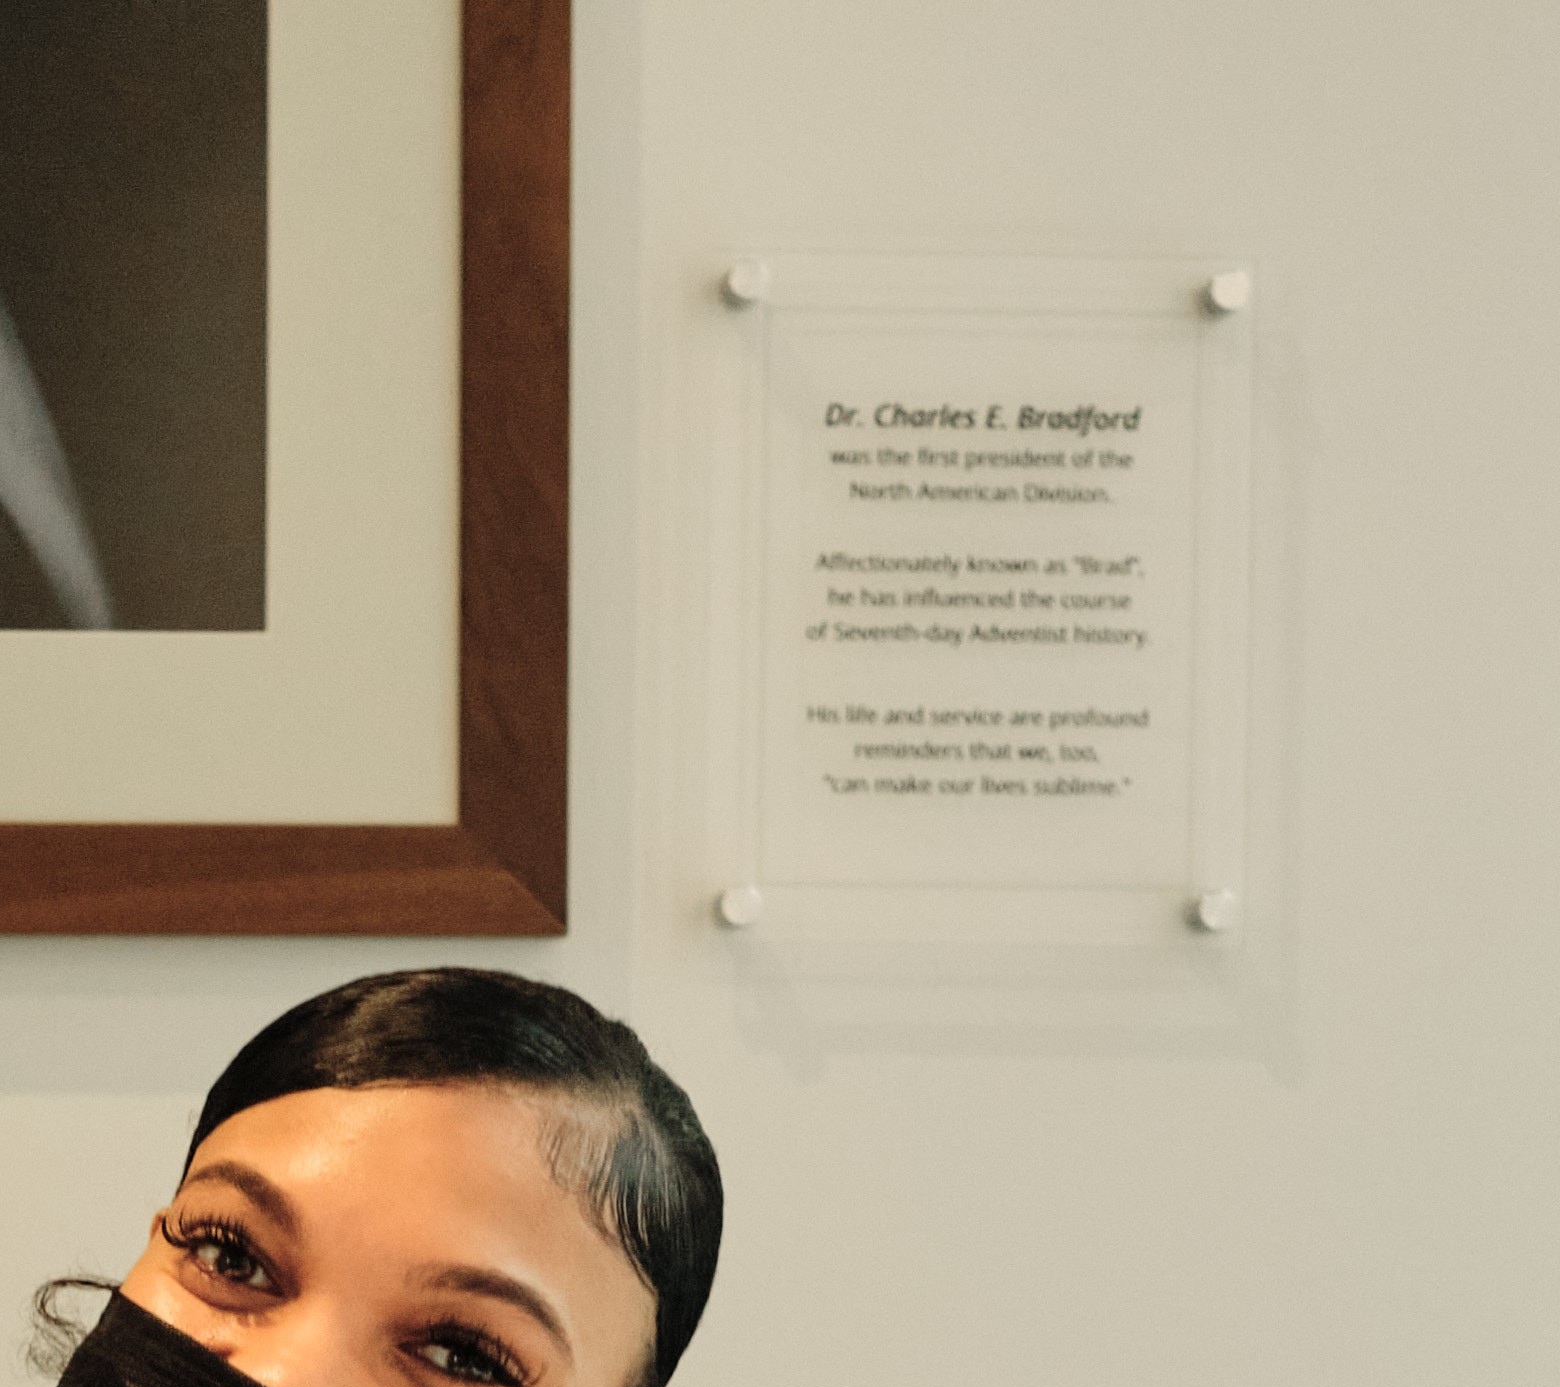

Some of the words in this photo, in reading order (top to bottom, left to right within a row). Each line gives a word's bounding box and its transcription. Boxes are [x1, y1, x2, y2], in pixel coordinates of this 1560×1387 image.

[825, 403, 864, 428] Dr.
[874, 403, 977, 430] Charles
[985, 405, 1007, 430] E.
[1017, 405, 1142, 436] Bradford
[830, 450, 870, 466] was
[876, 446, 912, 466] the
[917, 447, 958, 467] first
[965, 449, 1065, 470] president
[1072, 449, 1093, 468] of
[1099, 449, 1133, 470] the
[849, 482, 912, 501] North
[917, 483, 1018, 501] American
[815, 554, 959, 577] Affectionately
[967, 555, 1038, 575] known
[1044, 559, 1066, 575] as
[828, 587, 854, 607] he
[860, 589, 896, 607] has
[904, 587, 1013, 609] influenced
[1021, 589, 1054, 609] the
[1060, 593, 1131, 609] course
[805, 621, 828, 641] of
[834, 622, 962, 648] Seventh-day
[969, 624, 1067, 644] Adventist
[807, 705, 839, 724] His
[845, 705, 877, 724] life
[884, 706, 924, 726] and
[930, 708, 1002, 726] service
[1008, 711, 1043, 727] are
[1049, 708, 1149, 730] profound
[854, 742, 963, 760] reminders
[969, 743, 1011, 761] that
[875, 776, 932, 795] make
[939, 778, 974, 795] our
[980, 777, 1027, 796] lives
